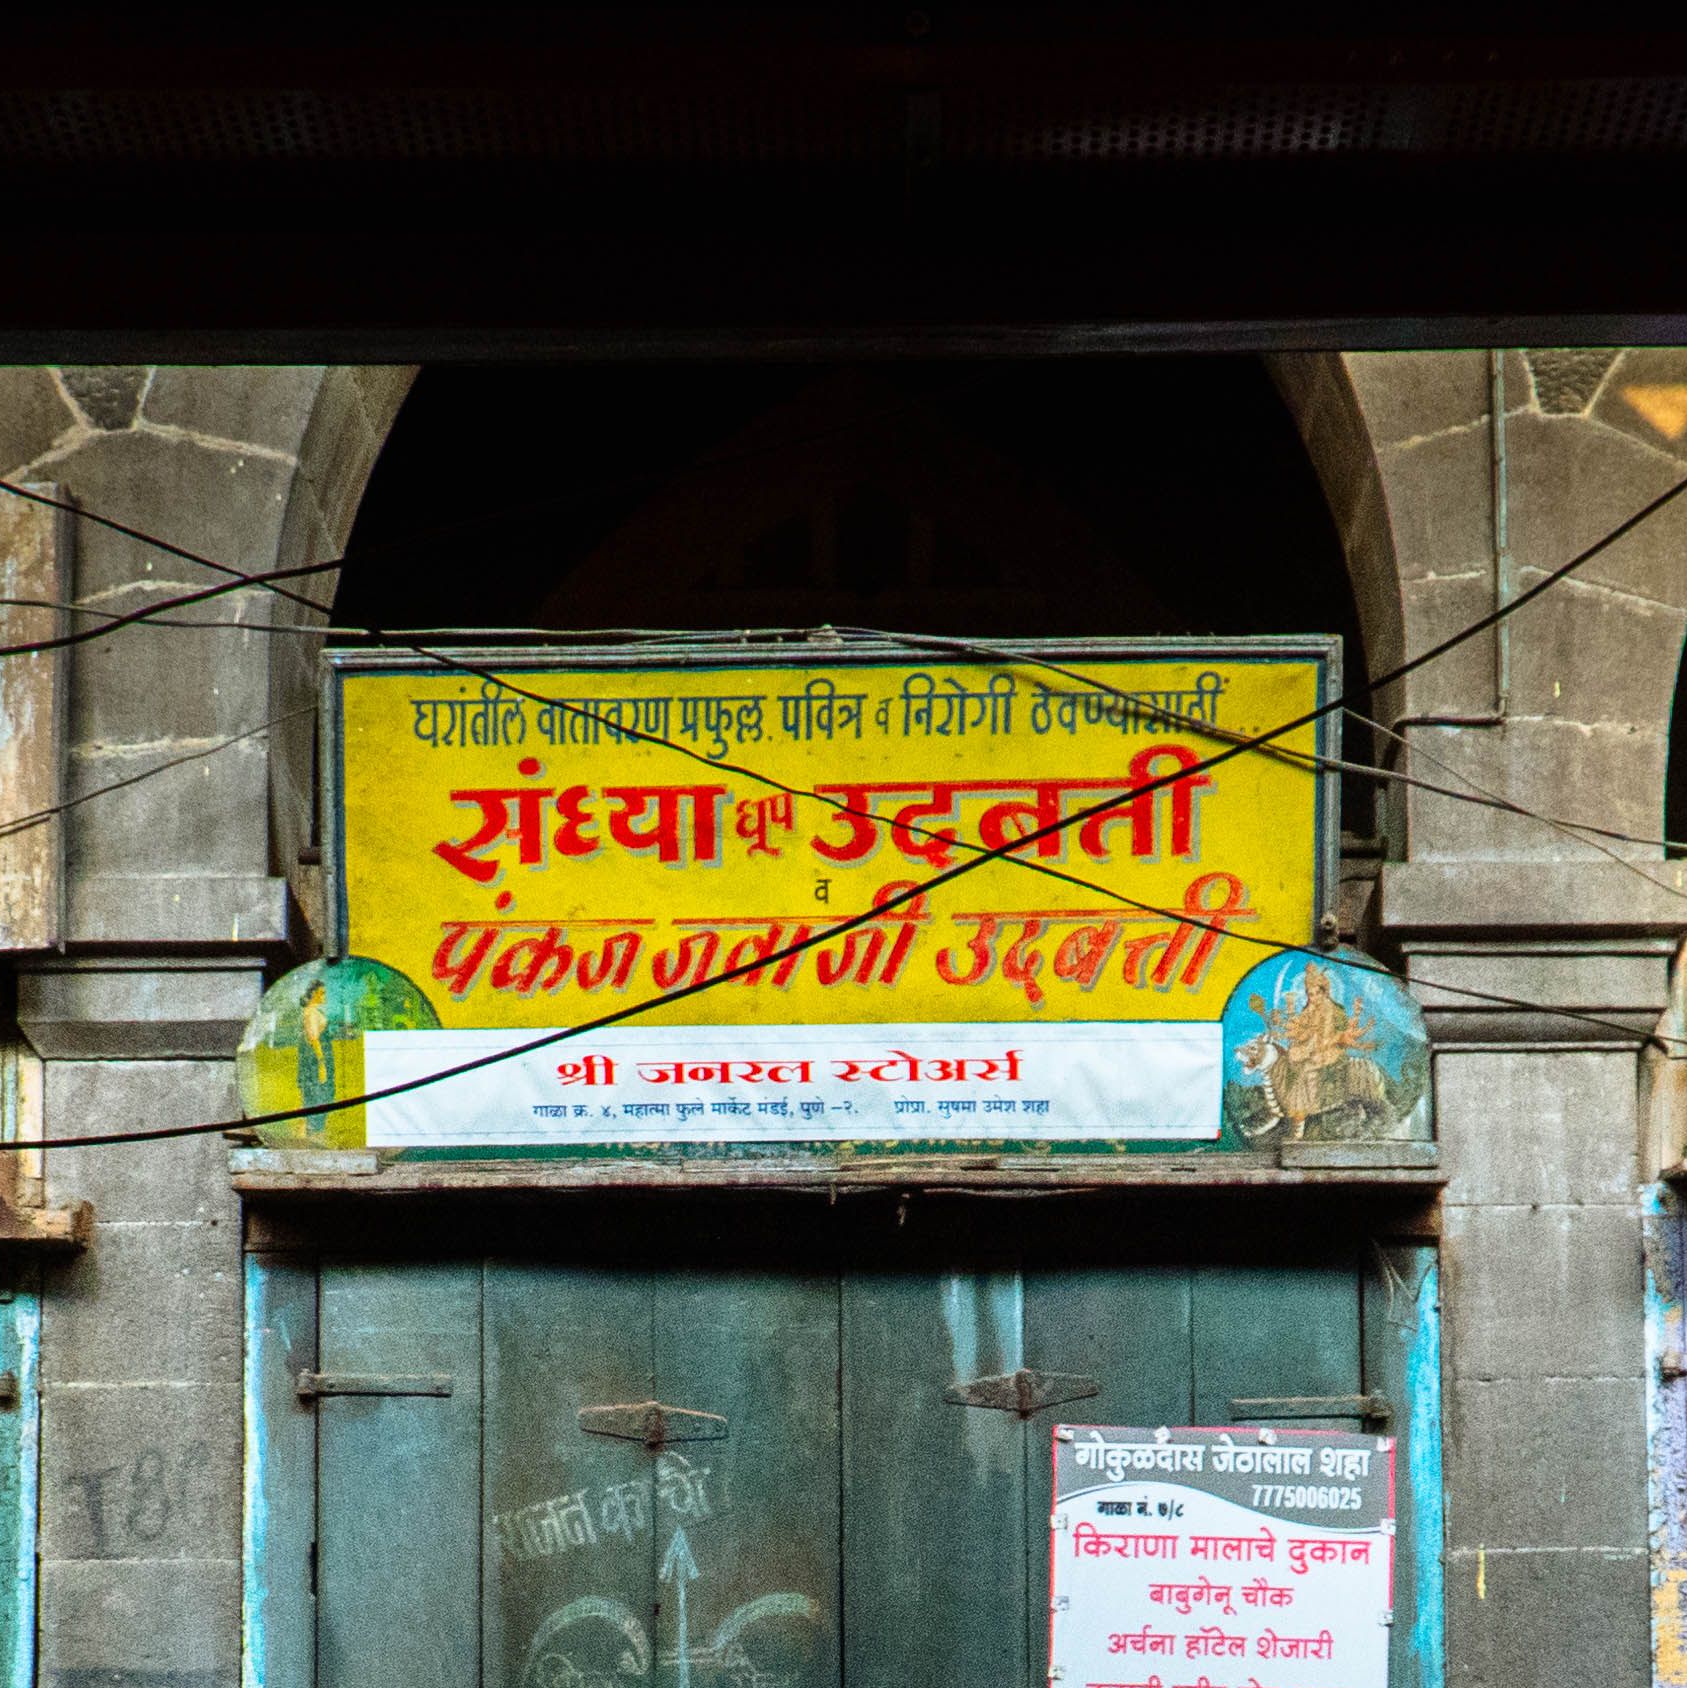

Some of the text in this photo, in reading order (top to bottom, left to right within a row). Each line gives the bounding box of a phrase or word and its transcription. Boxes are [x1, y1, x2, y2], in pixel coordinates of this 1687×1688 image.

[537, 696, 672, 745] वातावरण
[777, 678, 866, 741] पवित्र
[875, 697, 893, 735] व
[899, 673, 1017, 737] निरोगी
[431, 757, 730, 884] संध्या
[735, 793, 795, 858] धूप
[814, 879, 832, 904] व
[432, 889, 656, 995] पंकज
[557, 1050, 1024, 1086] श्री जनरल स्टोअर्स
[533, 1104, 567, 1118] गाळा
[572, 1104, 593, 1119] क्र.
[622, 1103, 671, 1119] महात्मा
[675, 1097, 704, 1122] फुले
[711, 1097, 751, 1116] मार्केट
[758, 1096, 794, 1119] मंडई,
[800, 1097, 825, 1121] पुणे
[894, 1095, 930, 1115] प्रोप्रा.
[938, 1099, 976, 1119] सुषमा
[983, 1095, 1016, 1113] उमेश
[1022, 1099, 1050, 1116] शहा
[1074, 1431, 1371, 1481] गोकुळदास जेठालाल शहा
[1097, 1501, 1132, 1516] गाळा
[1251, 1484, 1362, 1511] 7775006025
[1072, 1522, 1372, 1574] किराणा मालाचे दुकान
[1149, 1576, 1294, 1616] बाबुगेनू चौक
[1108, 1624, 1334, 1660] अर्चना हॉटेल शेजारी
